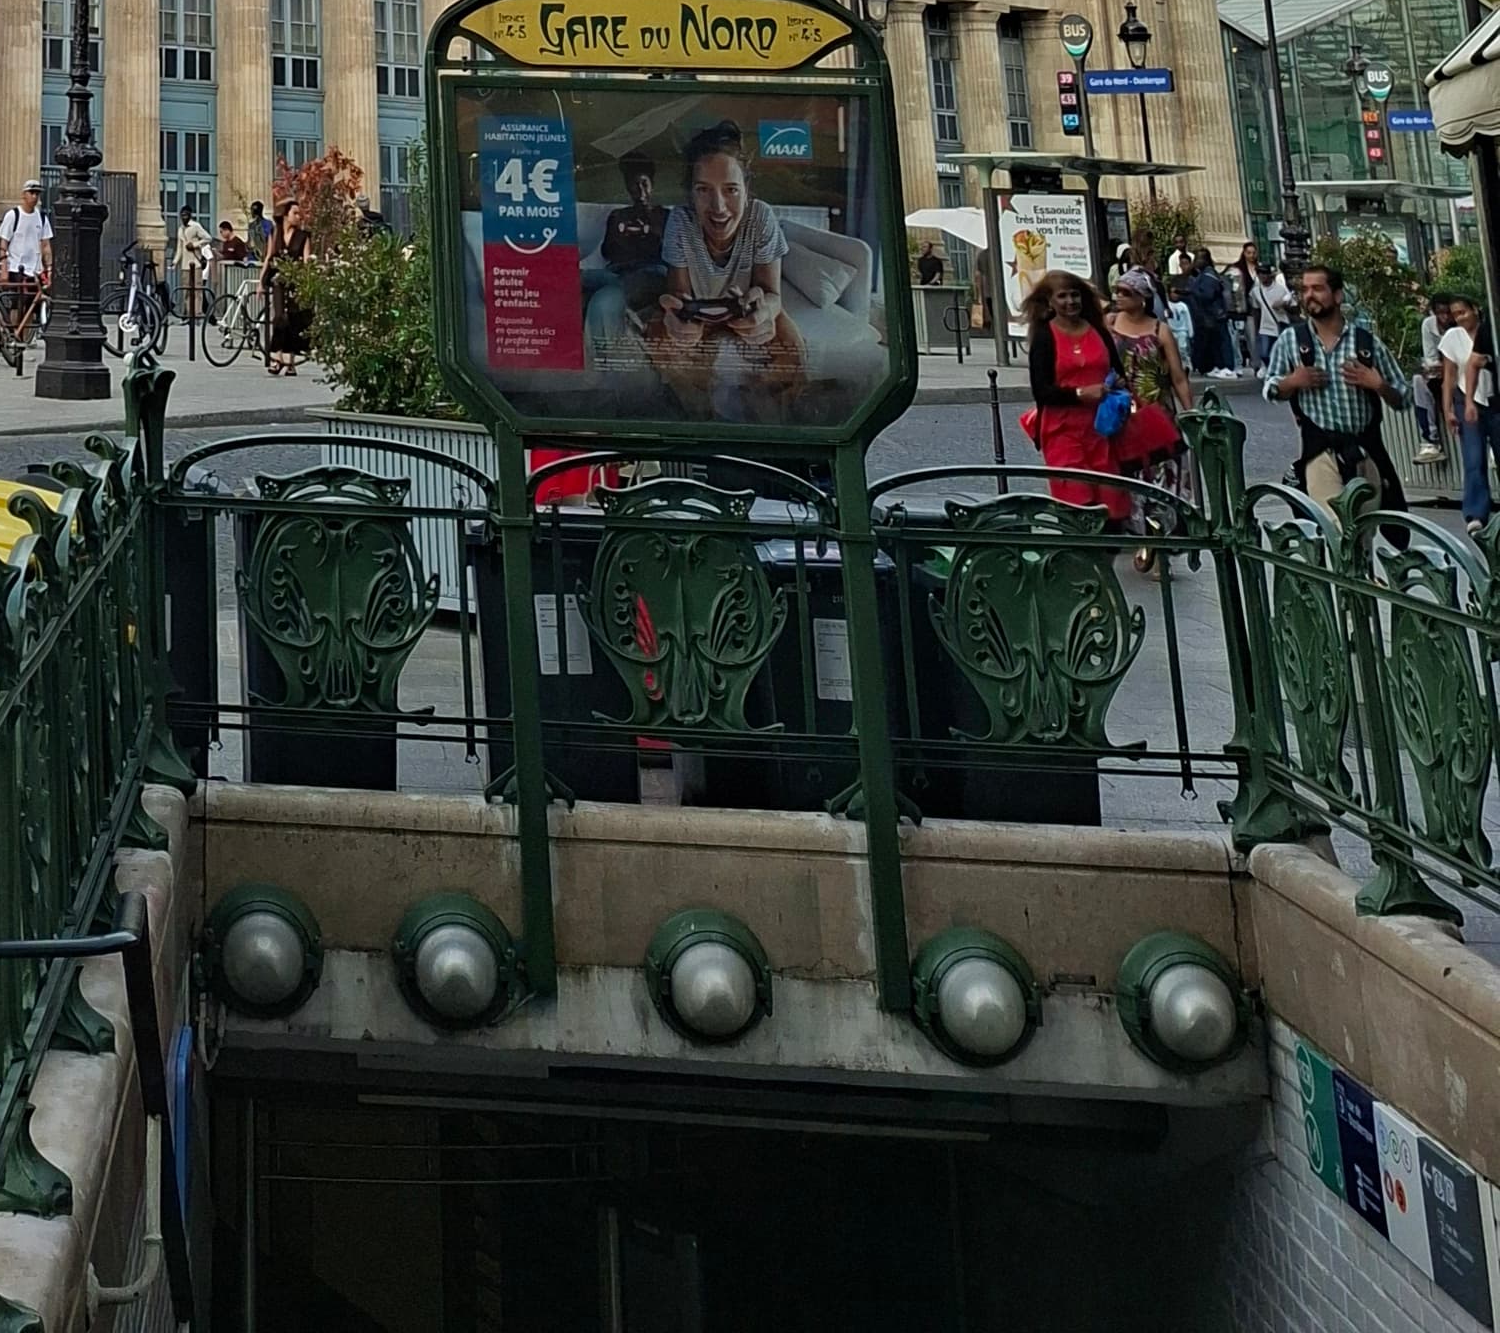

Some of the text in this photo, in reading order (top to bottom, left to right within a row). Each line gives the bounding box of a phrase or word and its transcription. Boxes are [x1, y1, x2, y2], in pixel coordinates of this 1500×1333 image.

[539, 3, 777, 59] GARE DU NORD
[1063, 24, 1086, 37] BUS
[1367, 71, 1389, 82] BUS
[500, 123, 549, 132] ASSURANCE
[484, 133, 567, 143] HABITATION JEUNES
[765, 143, 809, 156] MAAF
[495, 158, 560, 203] 4€
[499, 206, 524, 217] PAR
[1033, 205, 1082, 215] Essaouira
[1015, 215, 1082, 225] très bien avec
[1036, 226, 1083, 235] vos frites.
[493, 267, 529, 276] Devenir
[494, 278, 524, 286] adulte
[494, 289, 509, 297] est
[524, 289, 540, 299] jeu
[495, 299, 541, 308] d'enfants.
[495, 317, 533, 325] Disponible
[506, 327, 539, 336] quelques
[505, 337, 529, 346] profite
[531, 337, 550, 345] aussi
